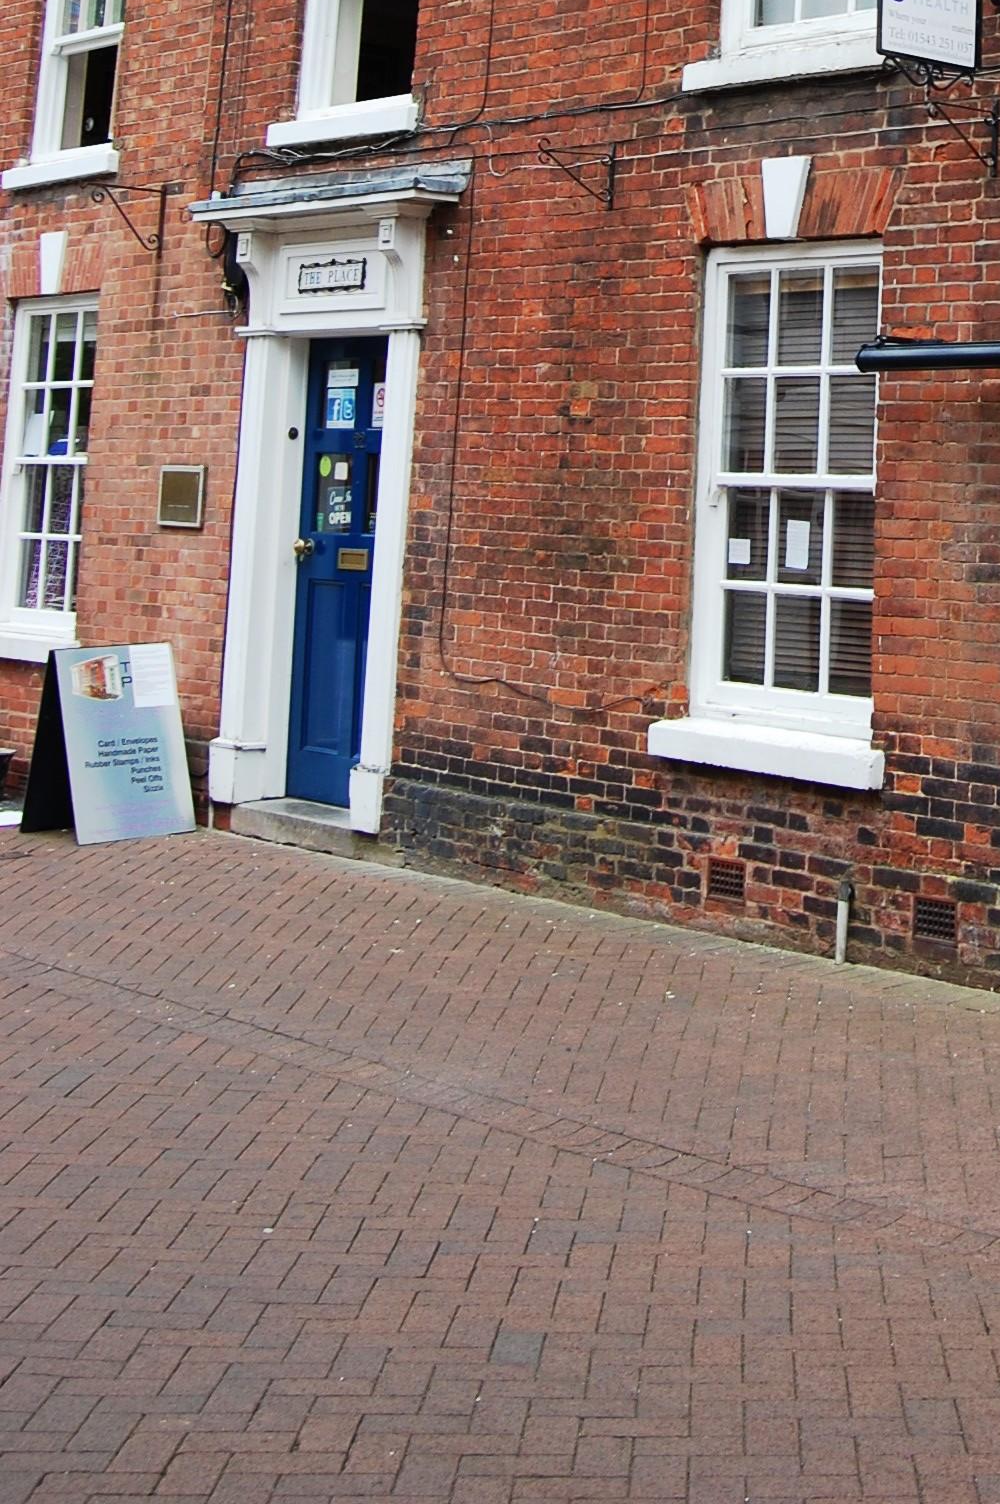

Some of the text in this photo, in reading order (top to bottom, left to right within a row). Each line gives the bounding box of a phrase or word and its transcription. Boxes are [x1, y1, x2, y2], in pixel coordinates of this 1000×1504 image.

[907, 29, 936, 45] 01543
[938, 36, 954, 51] 251
[304, 268, 360, 286] THE PLACE
